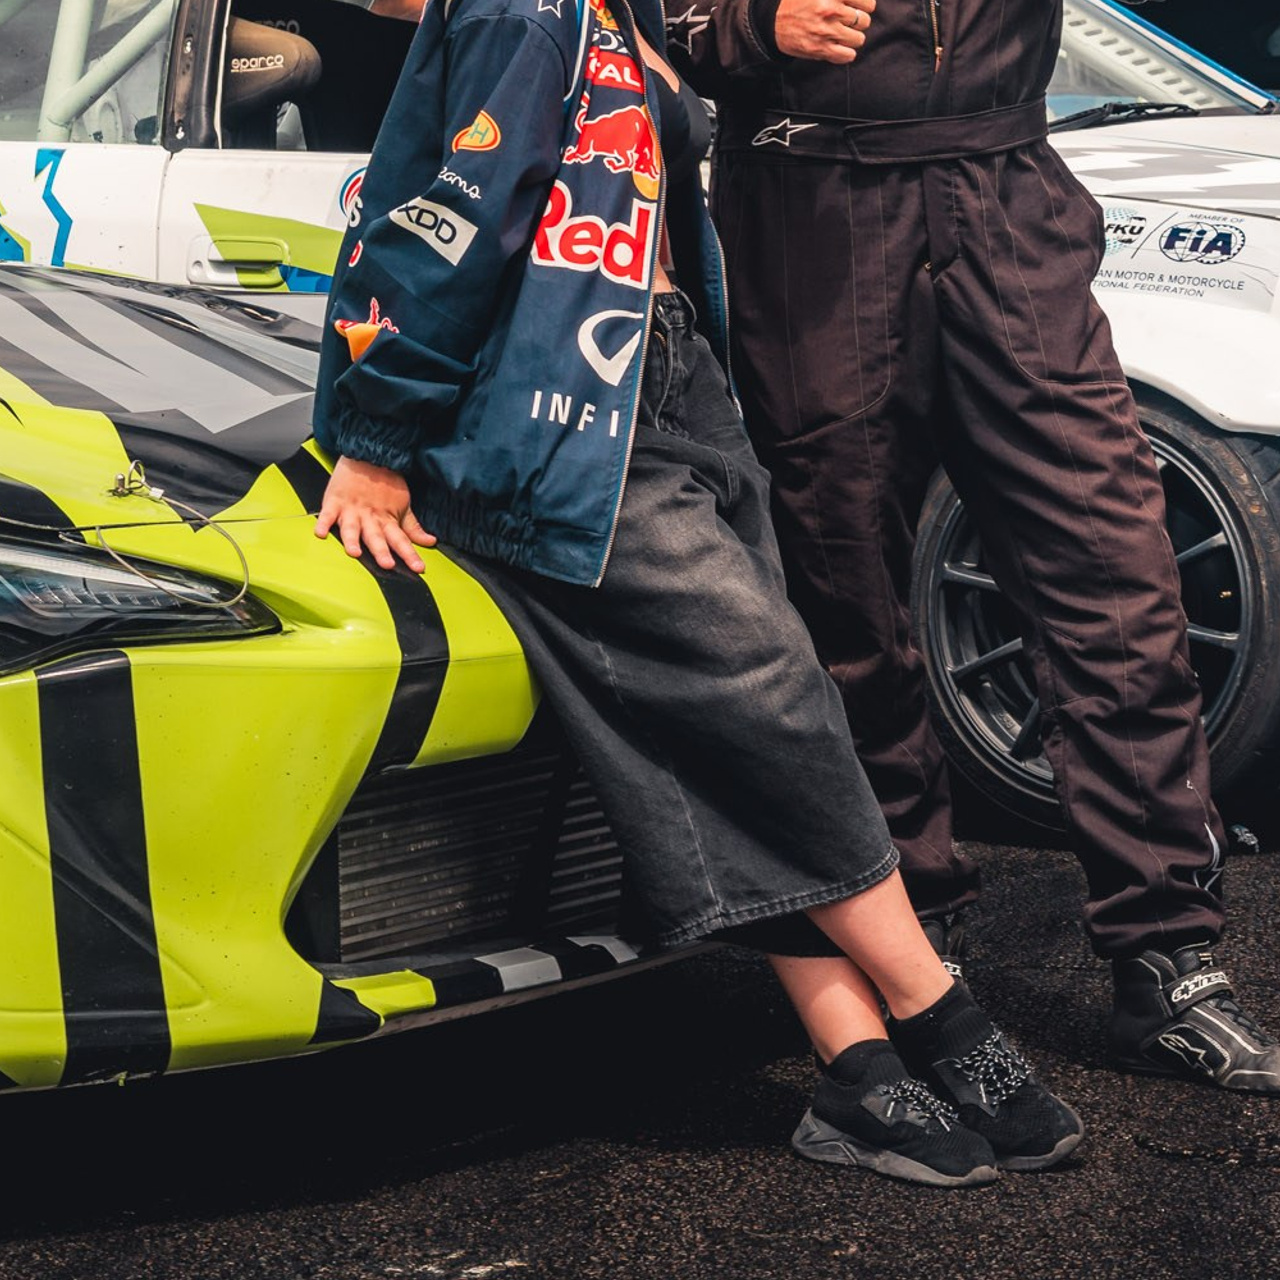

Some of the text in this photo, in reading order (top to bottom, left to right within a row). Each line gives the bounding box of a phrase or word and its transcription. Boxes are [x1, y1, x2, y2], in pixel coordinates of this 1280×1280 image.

[231, 54, 284, 73] sparco
[1189, 214, 1227, 222] MEMBER
[532, 181, 657, 290] Red
[1115, 270, 1155, 281] MOTOR
[1157, 274, 1164, 282] &
[1168, 275, 1245, 291] MOTORCYCLE
[1133, 283, 1205, 297] FEDERATION
[530, 390, 620, 438] INFI
